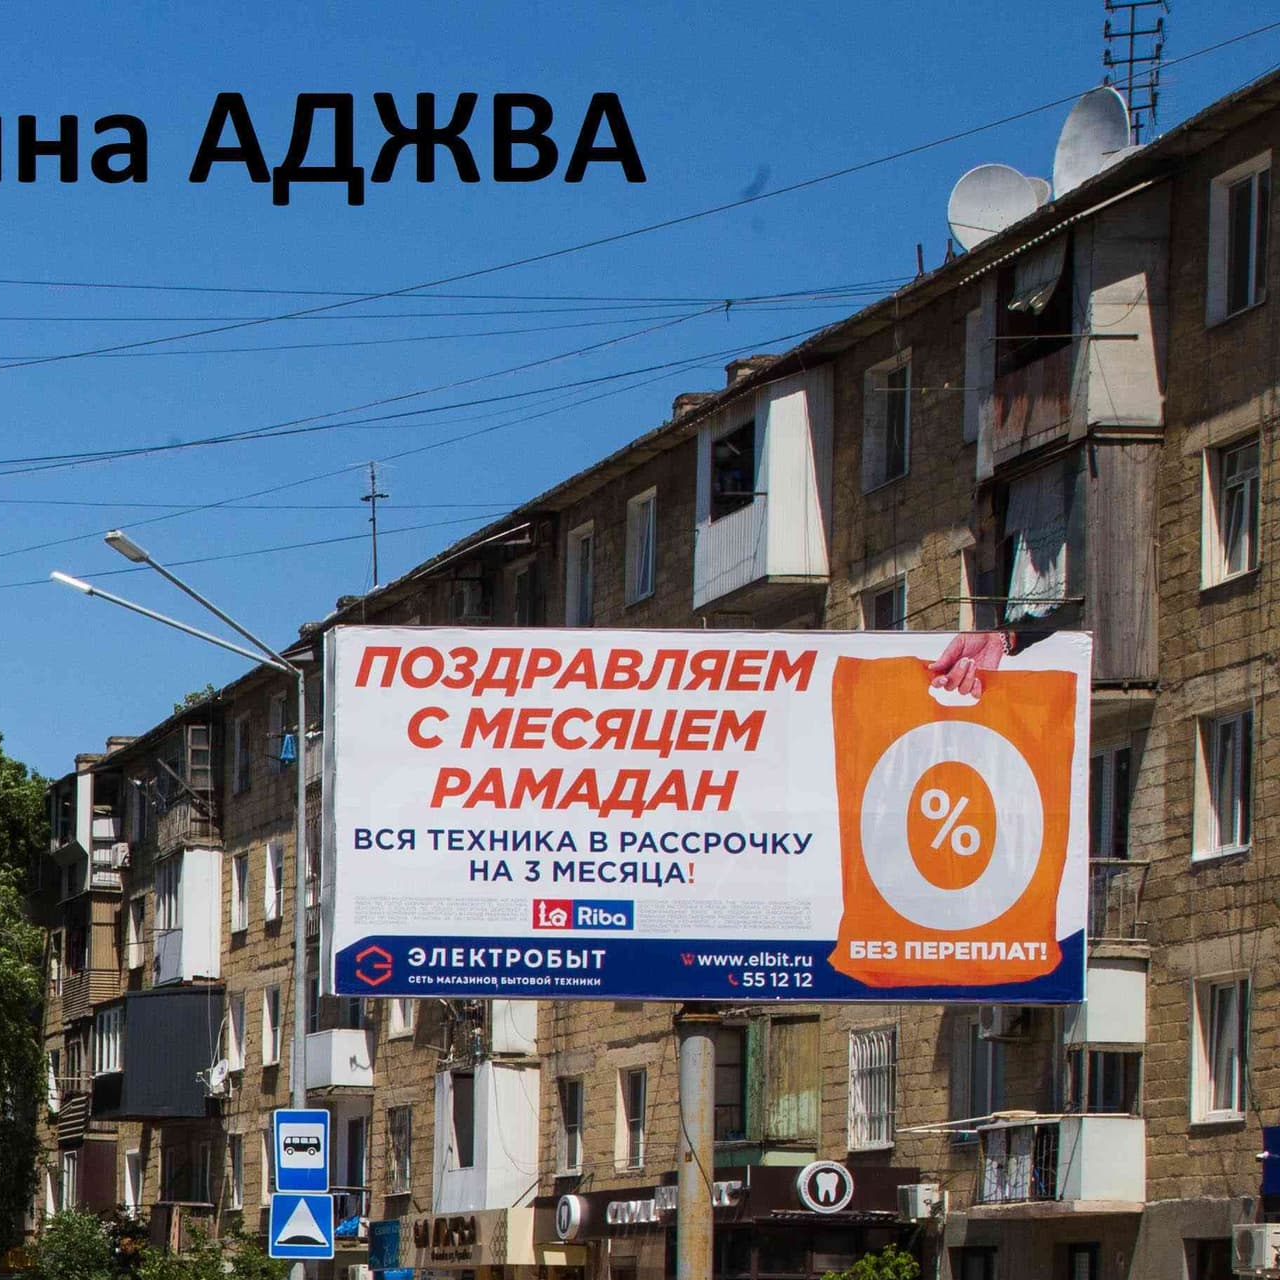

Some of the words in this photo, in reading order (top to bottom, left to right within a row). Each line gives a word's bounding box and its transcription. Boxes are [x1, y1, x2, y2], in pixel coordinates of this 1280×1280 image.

[354, 646, 818, 697] ПОЗДРАВЛЯЕМ
[407, 706, 449, 749] С
[460, 707, 767, 758] МЕСЯЦЕМ
[430, 767, 739, 818] РАМАДАН
[354, 828, 416, 851] ВСЯ
[427, 829, 578, 853] ТЕХНИКА
[589, 831, 608, 853] В
[620, 831, 814, 855] РАССРОЧКУ
[469, 860, 513, 882] НА
[524, 861, 541, 883] 3
[553, 861, 696, 887] МЕСЯЦА!
[539, 901, 568, 927] La
[578, 906, 626, 926] Riba
[407, 947, 607, 970] ЭЛЕКТРОБЫТ
[697, 952, 813, 968] www.elbit.ru
[849, 941, 898, 960] БЕЗ
[904, 941, 1048, 961] ПЕРЕПЛАТ!
[408, 975, 434, 984] СЕТЬ
[437, 976, 498, 985] МАГАЗИНОВ
[500, 975, 551, 985] БЫТОВОЙ
[554, 977, 601, 986] ТЕХНИКИ
[742, 972, 765, 987] 55
[771, 972, 789, 987] 12
[794, 972, 813, 987] 12
